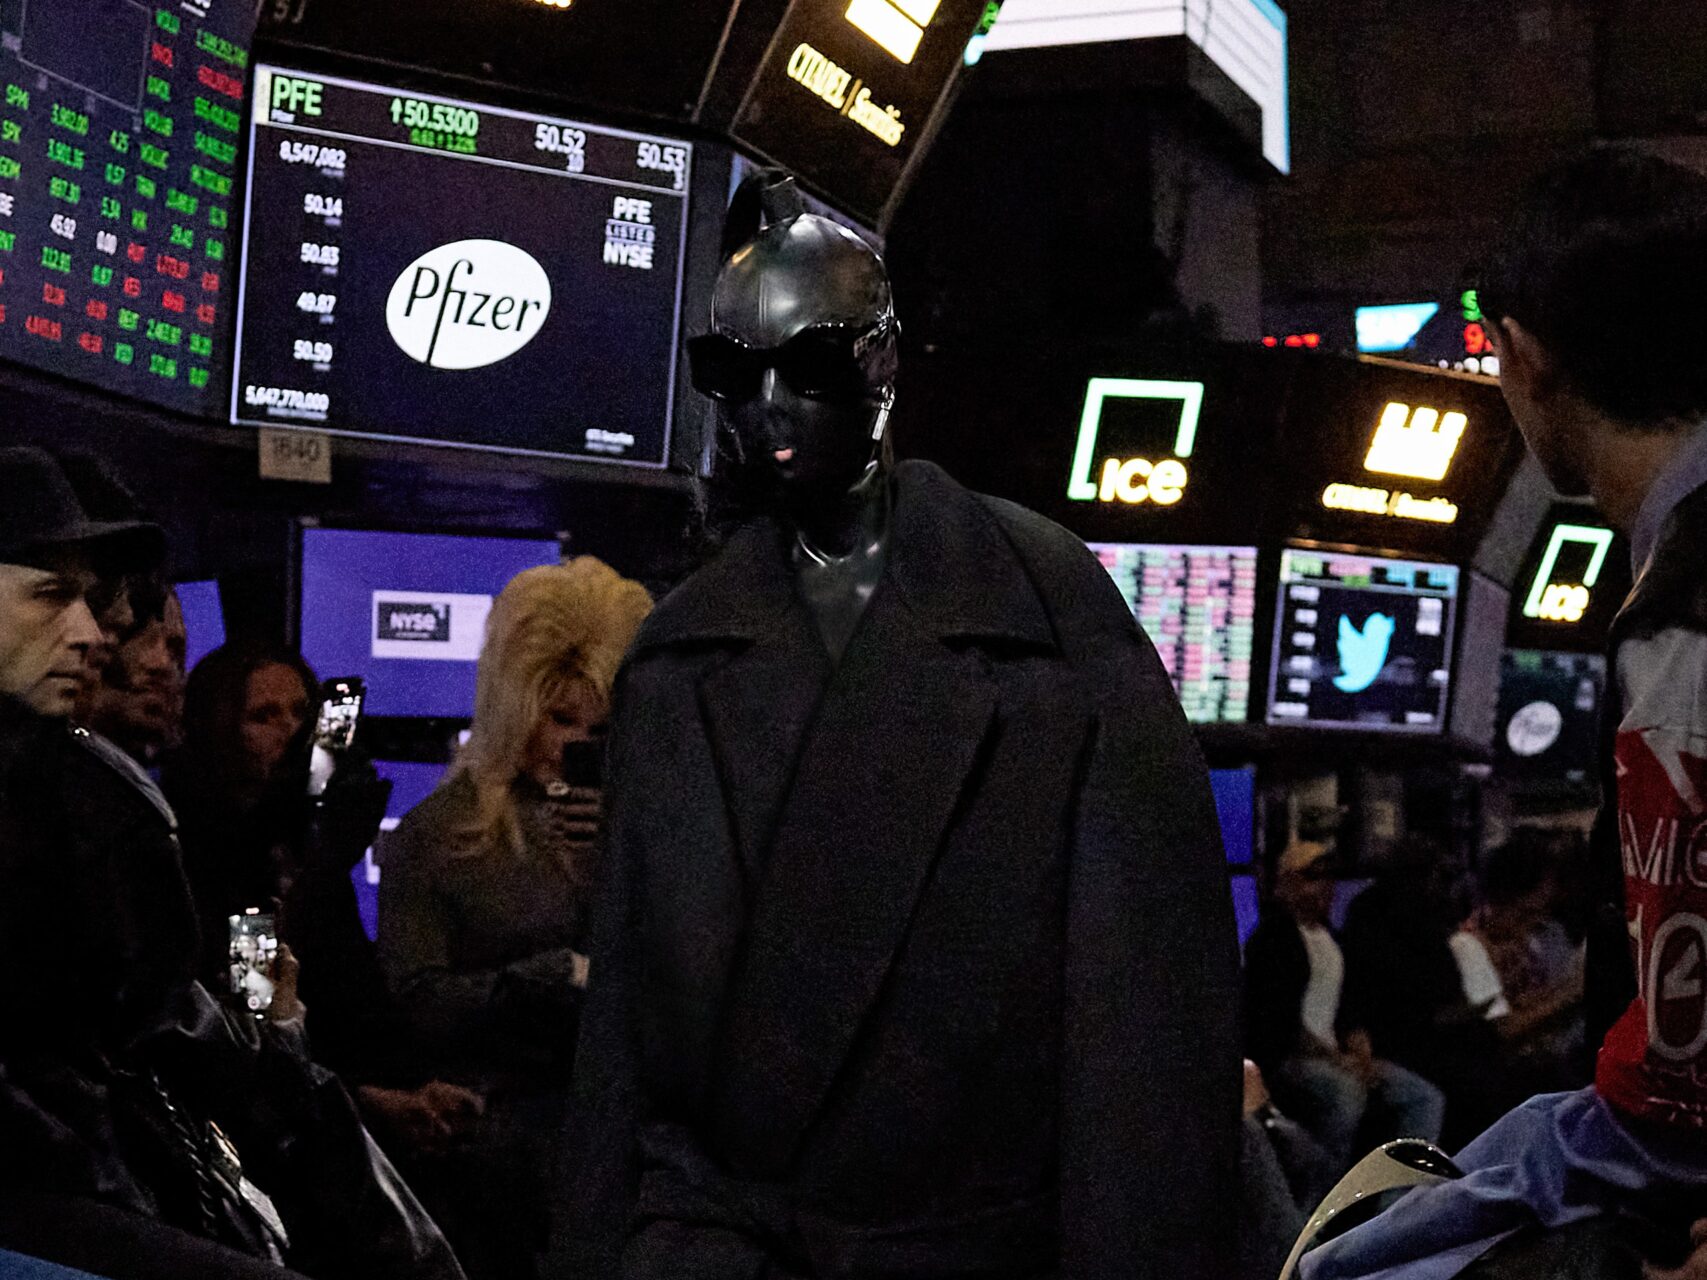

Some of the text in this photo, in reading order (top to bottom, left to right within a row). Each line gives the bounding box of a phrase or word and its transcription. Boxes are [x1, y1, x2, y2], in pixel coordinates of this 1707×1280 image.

[273, 76, 324, 116] PFE
[403, 99, 479, 137] 50.5300
[534, 123, 587, 154] 50.52
[636, 142, 686, 172] 50.53
[612, 196, 653, 224] PFE
[603, 241, 654, 270] NYSE
[404, 259, 541, 366] Pfizer
